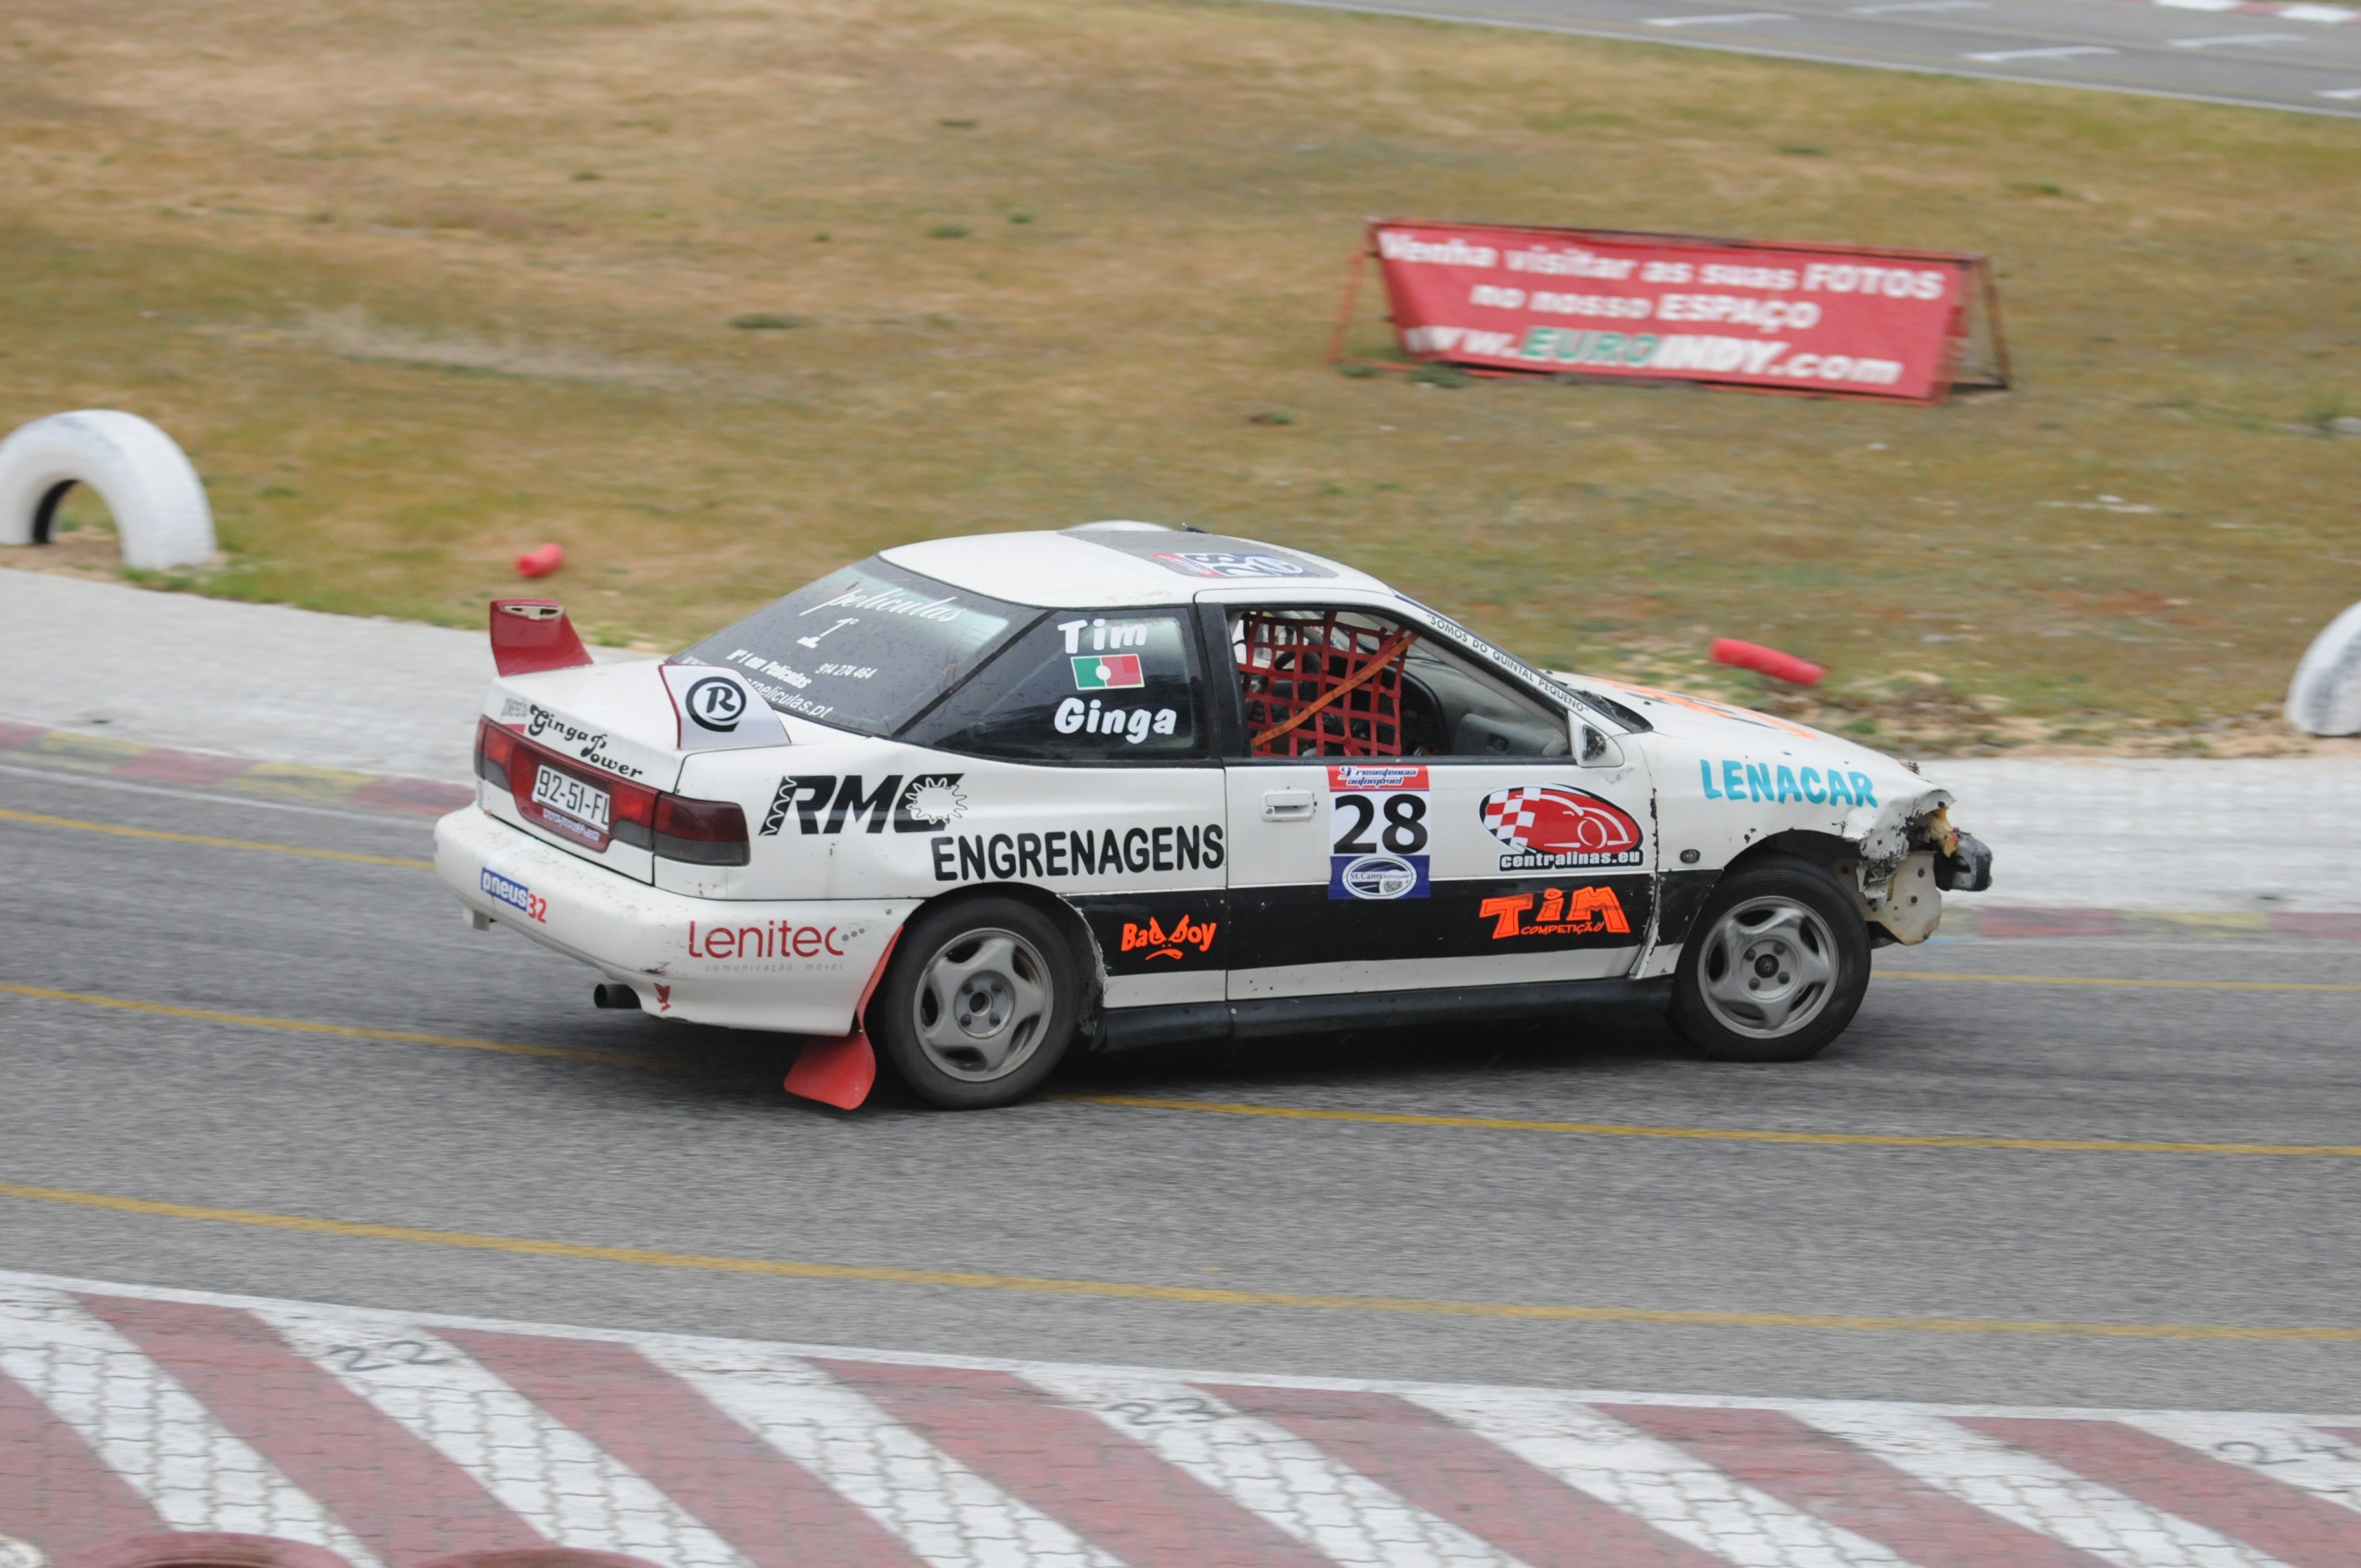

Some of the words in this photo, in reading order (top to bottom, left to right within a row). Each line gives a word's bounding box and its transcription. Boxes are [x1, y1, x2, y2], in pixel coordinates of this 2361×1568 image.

[1377, 231, 1498, 269] Venha
[1504, 244, 1639, 280] visitar
[1640, 260, 1694, 284] as
[1697, 264, 1798, 291] suas
[1802, 263, 1946, 300] FOTOS
[1469, 284, 1526, 309] no
[1528, 291, 1654, 319] nosso
[1656, 293, 1822, 334] ESPAÇO
[1057, 618, 1147, 654] Tim
[1473, 639, 1487, 653] DO
[1493, 651, 1534, 681] QUINTAL
[529, 704, 588, 741] Ginga
[580, 734, 643, 778] Power
[1053, 697, 1177, 744] Ginga
[537, 769, 610, 826] 92-51-FL
[1700, 759, 1879, 808] LENACAR
[1333, 794, 1428, 854] 28
[931, 824, 1225, 881] ENGRENAGENS
[1501, 851, 1640, 868] centralinas.eu
[1520, 921, 1603, 935] COMPETIÇÃO
